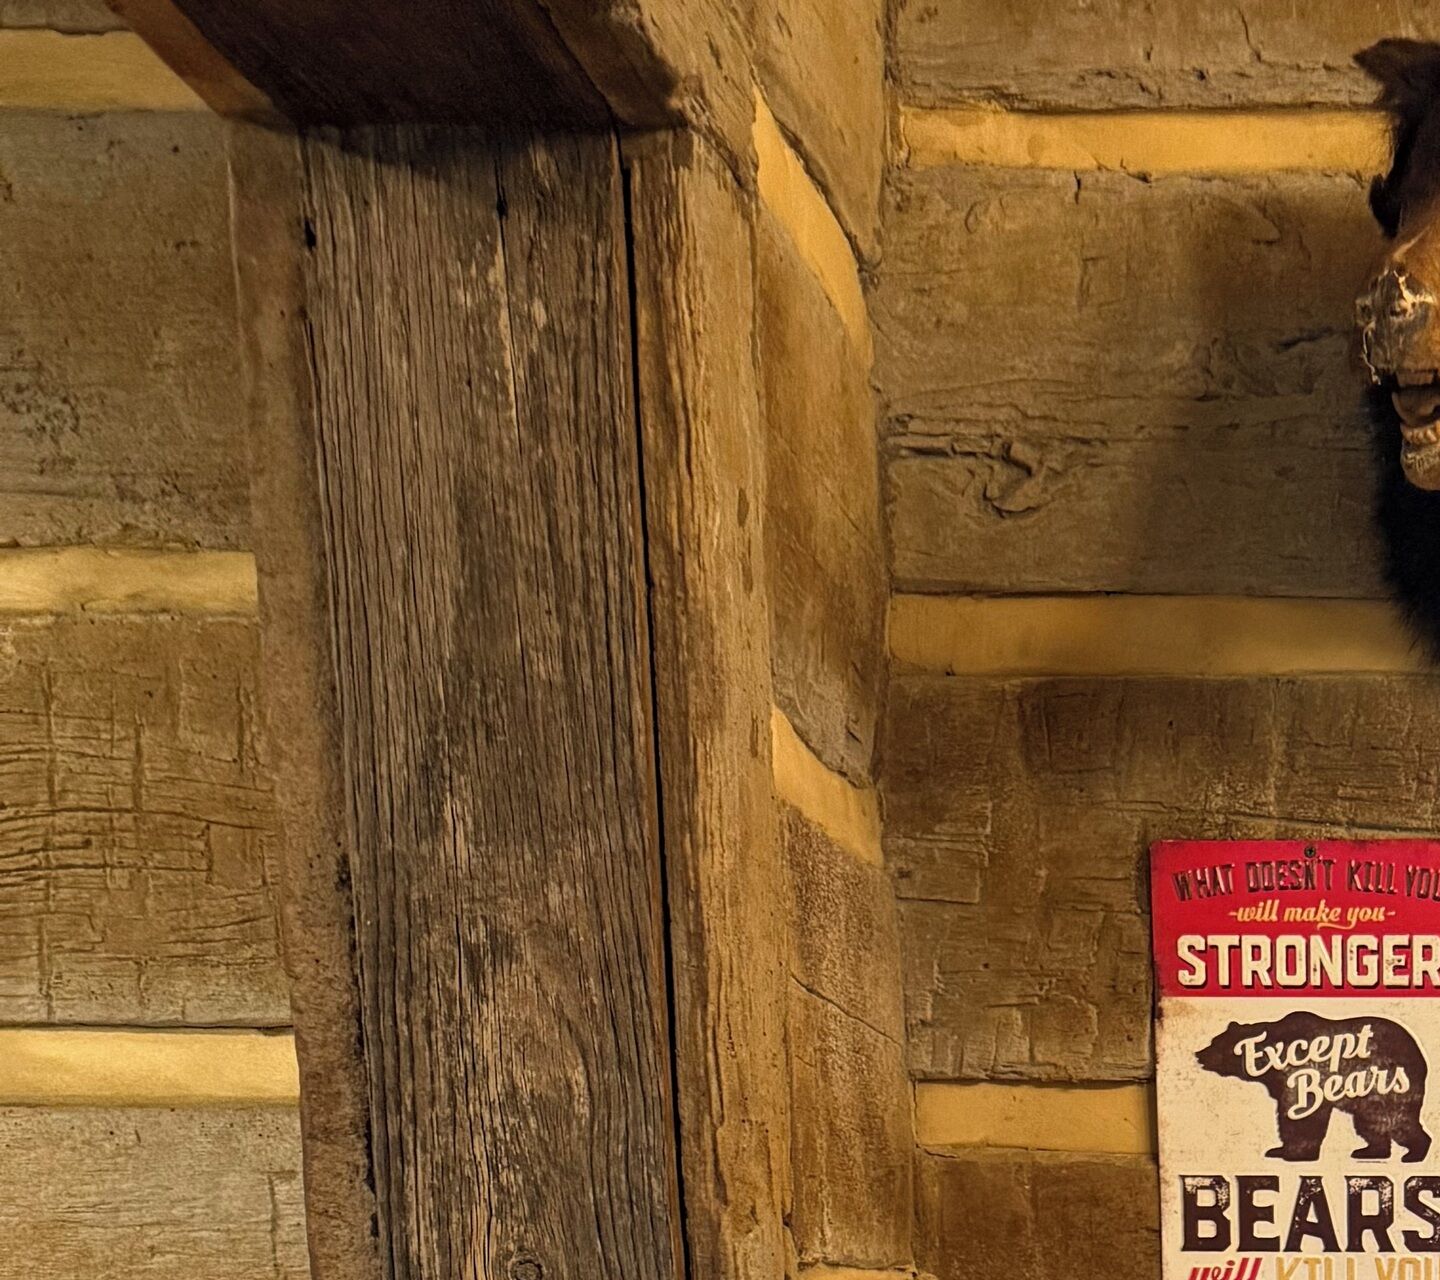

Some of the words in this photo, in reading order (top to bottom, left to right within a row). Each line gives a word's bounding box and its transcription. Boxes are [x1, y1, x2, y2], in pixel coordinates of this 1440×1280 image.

[1172, 863, 1235, 901] WHAT
[1246, 855, 1336, 892] DOESN'T
[1348, 860, 1398, 894] KILL
[1284, 900, 1340, 923] make
[1233, 1024, 1374, 1077] Except
[1286, 1065, 1410, 1120] Bears
